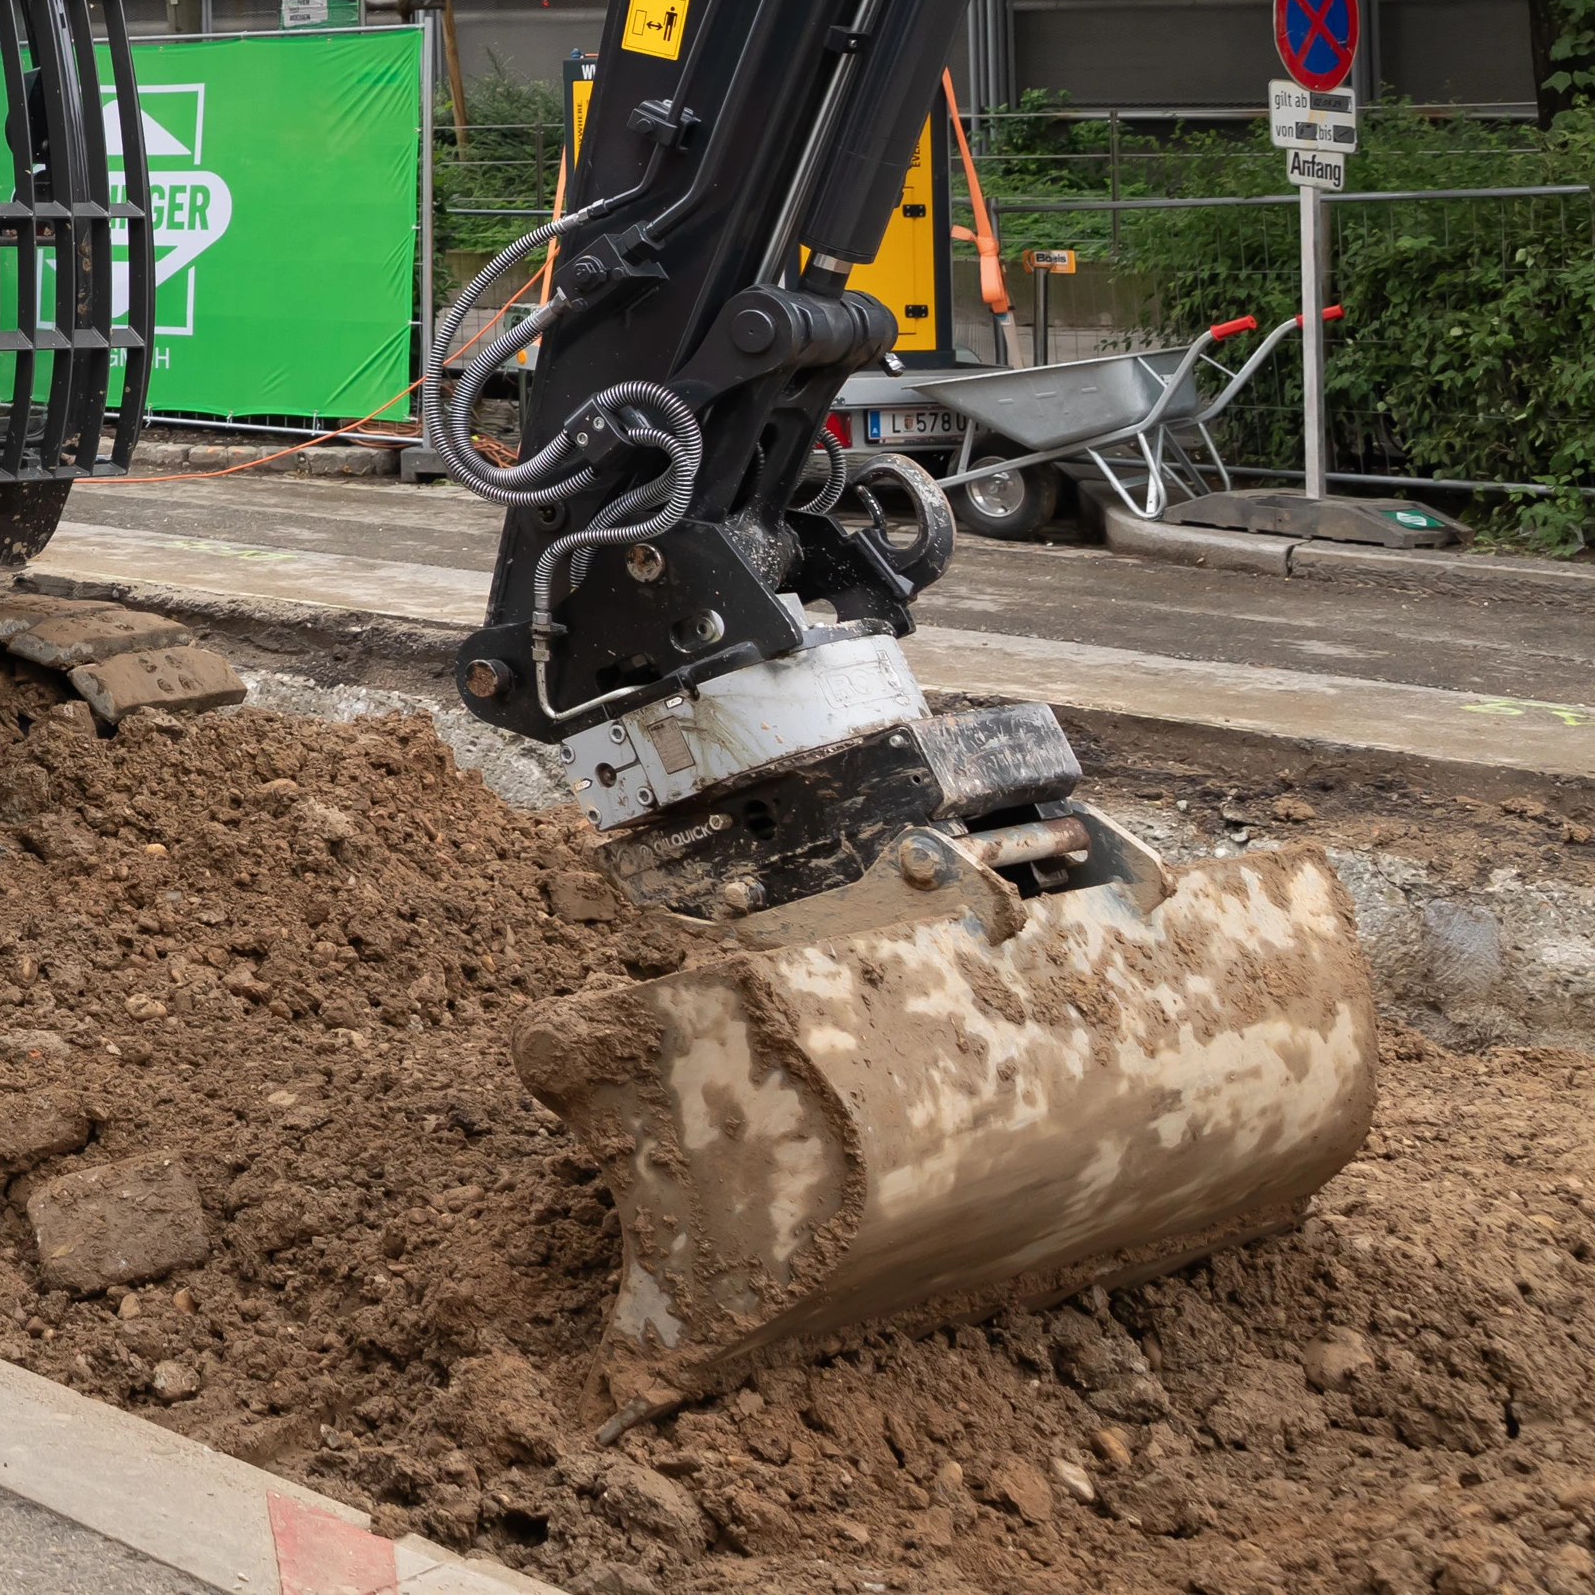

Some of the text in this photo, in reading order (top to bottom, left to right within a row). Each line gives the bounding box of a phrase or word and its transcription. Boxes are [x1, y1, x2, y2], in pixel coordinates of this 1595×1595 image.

[1274, 90, 1292, 109] gilt
[1294, 92, 1307, 108] ab
[1275, 125, 1294, 138] von
[1318, 124, 1332, 141] bis
[1290, 151, 1341, 187] Anfang
[892, 413, 901, 434] L
